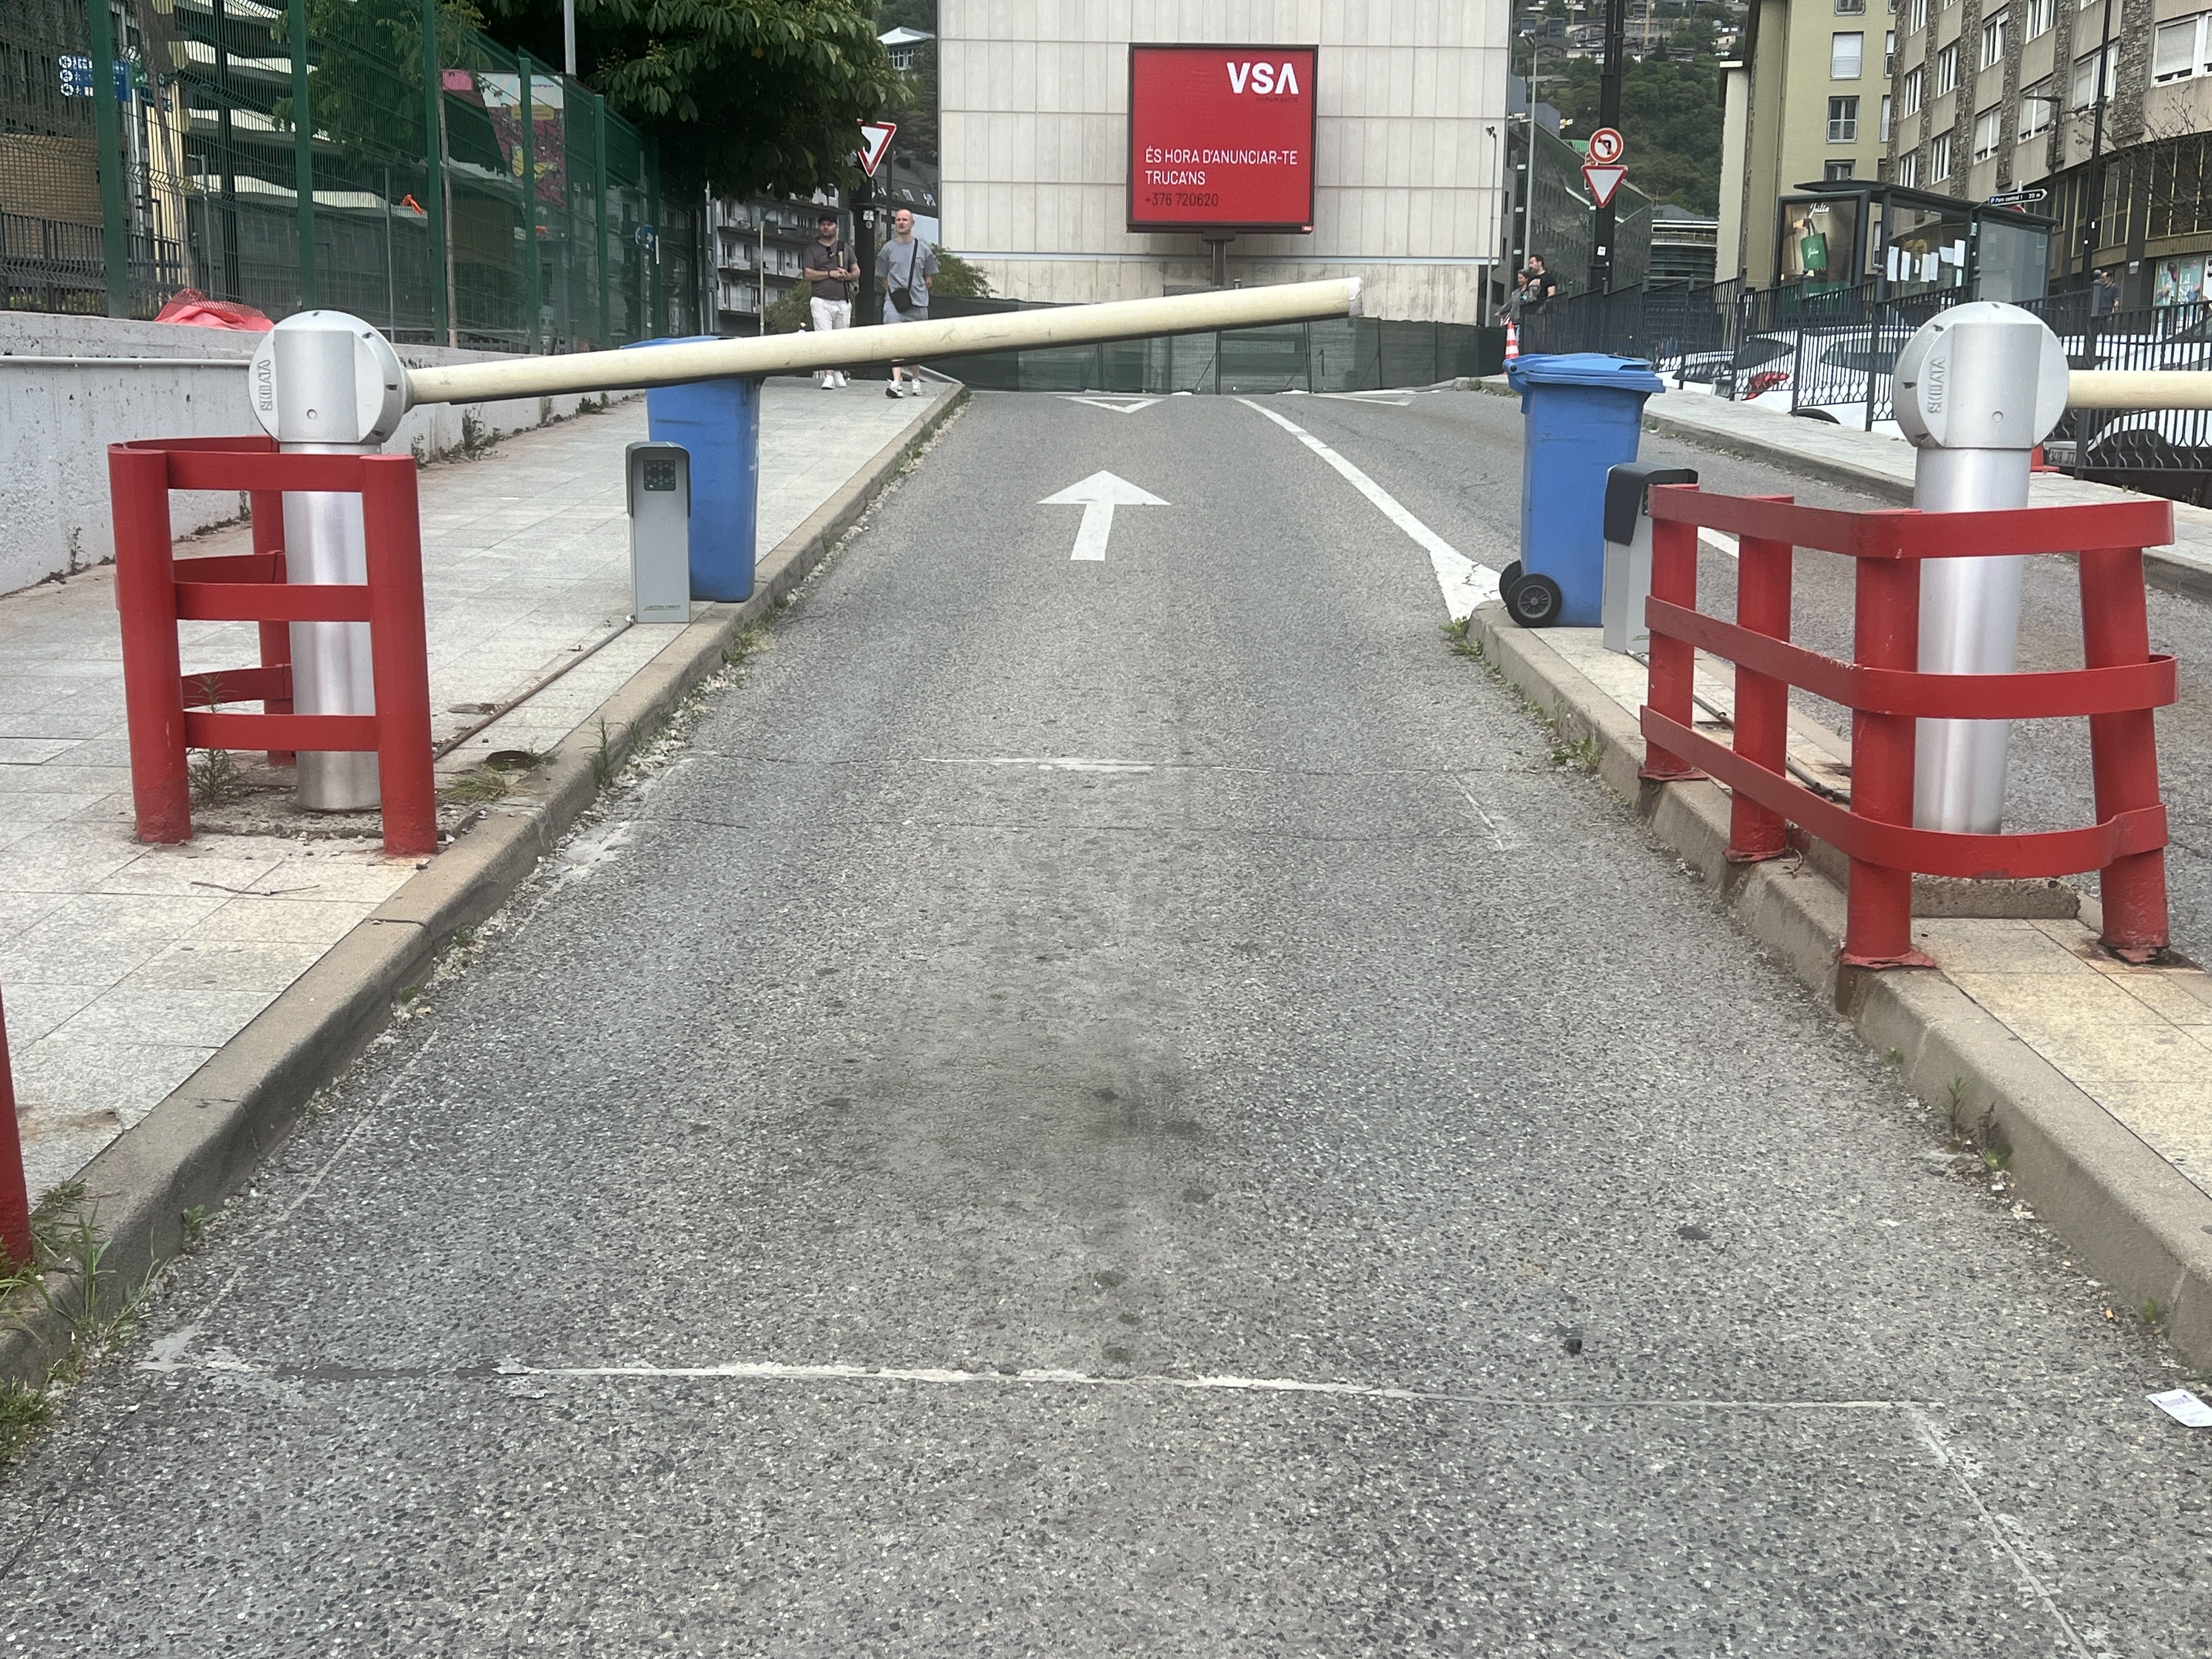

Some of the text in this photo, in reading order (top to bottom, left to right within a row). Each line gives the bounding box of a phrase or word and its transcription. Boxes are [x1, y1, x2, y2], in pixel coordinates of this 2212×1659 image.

[1226, 62, 1299, 94] VSA
[1146, 145, 1298, 165] ÉS HORA D'ANUNCIAR-TE
[1146, 170, 1206, 185] TRUCA'NS
[1145, 193, 1219, 207] +376 720620
[257, 359, 273, 411] SKIDATA
[1927, 356, 1946, 414] SKIDATA
